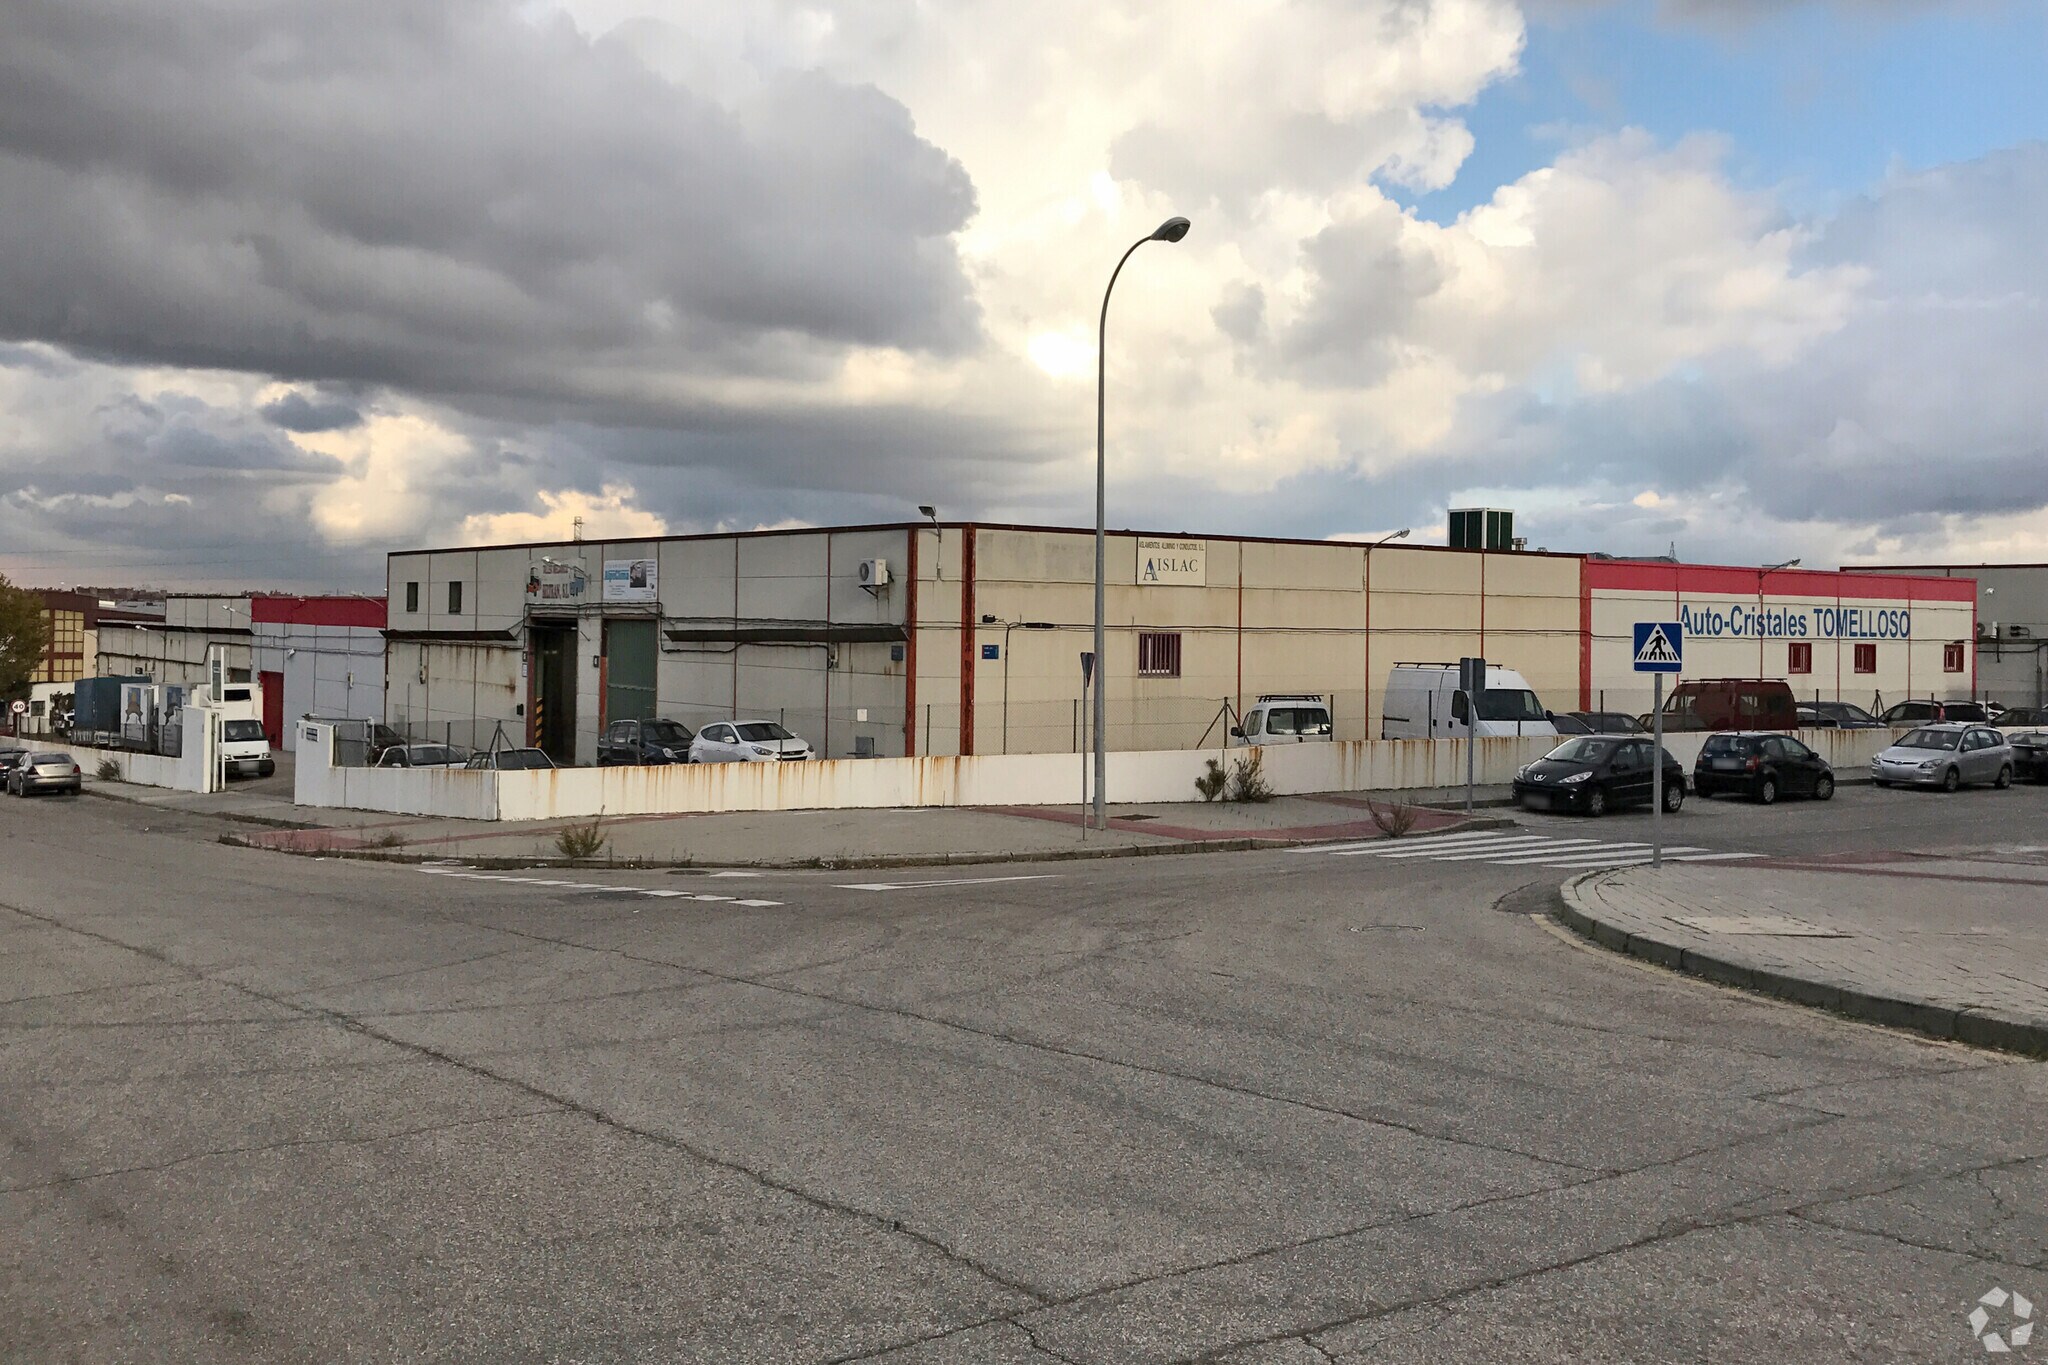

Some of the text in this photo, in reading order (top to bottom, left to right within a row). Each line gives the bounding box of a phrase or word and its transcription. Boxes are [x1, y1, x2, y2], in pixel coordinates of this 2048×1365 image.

[1143, 558, 1198, 581] AISLAC
[1681, 604, 1910, 638] Auto-Cristales TOMELLOSO
